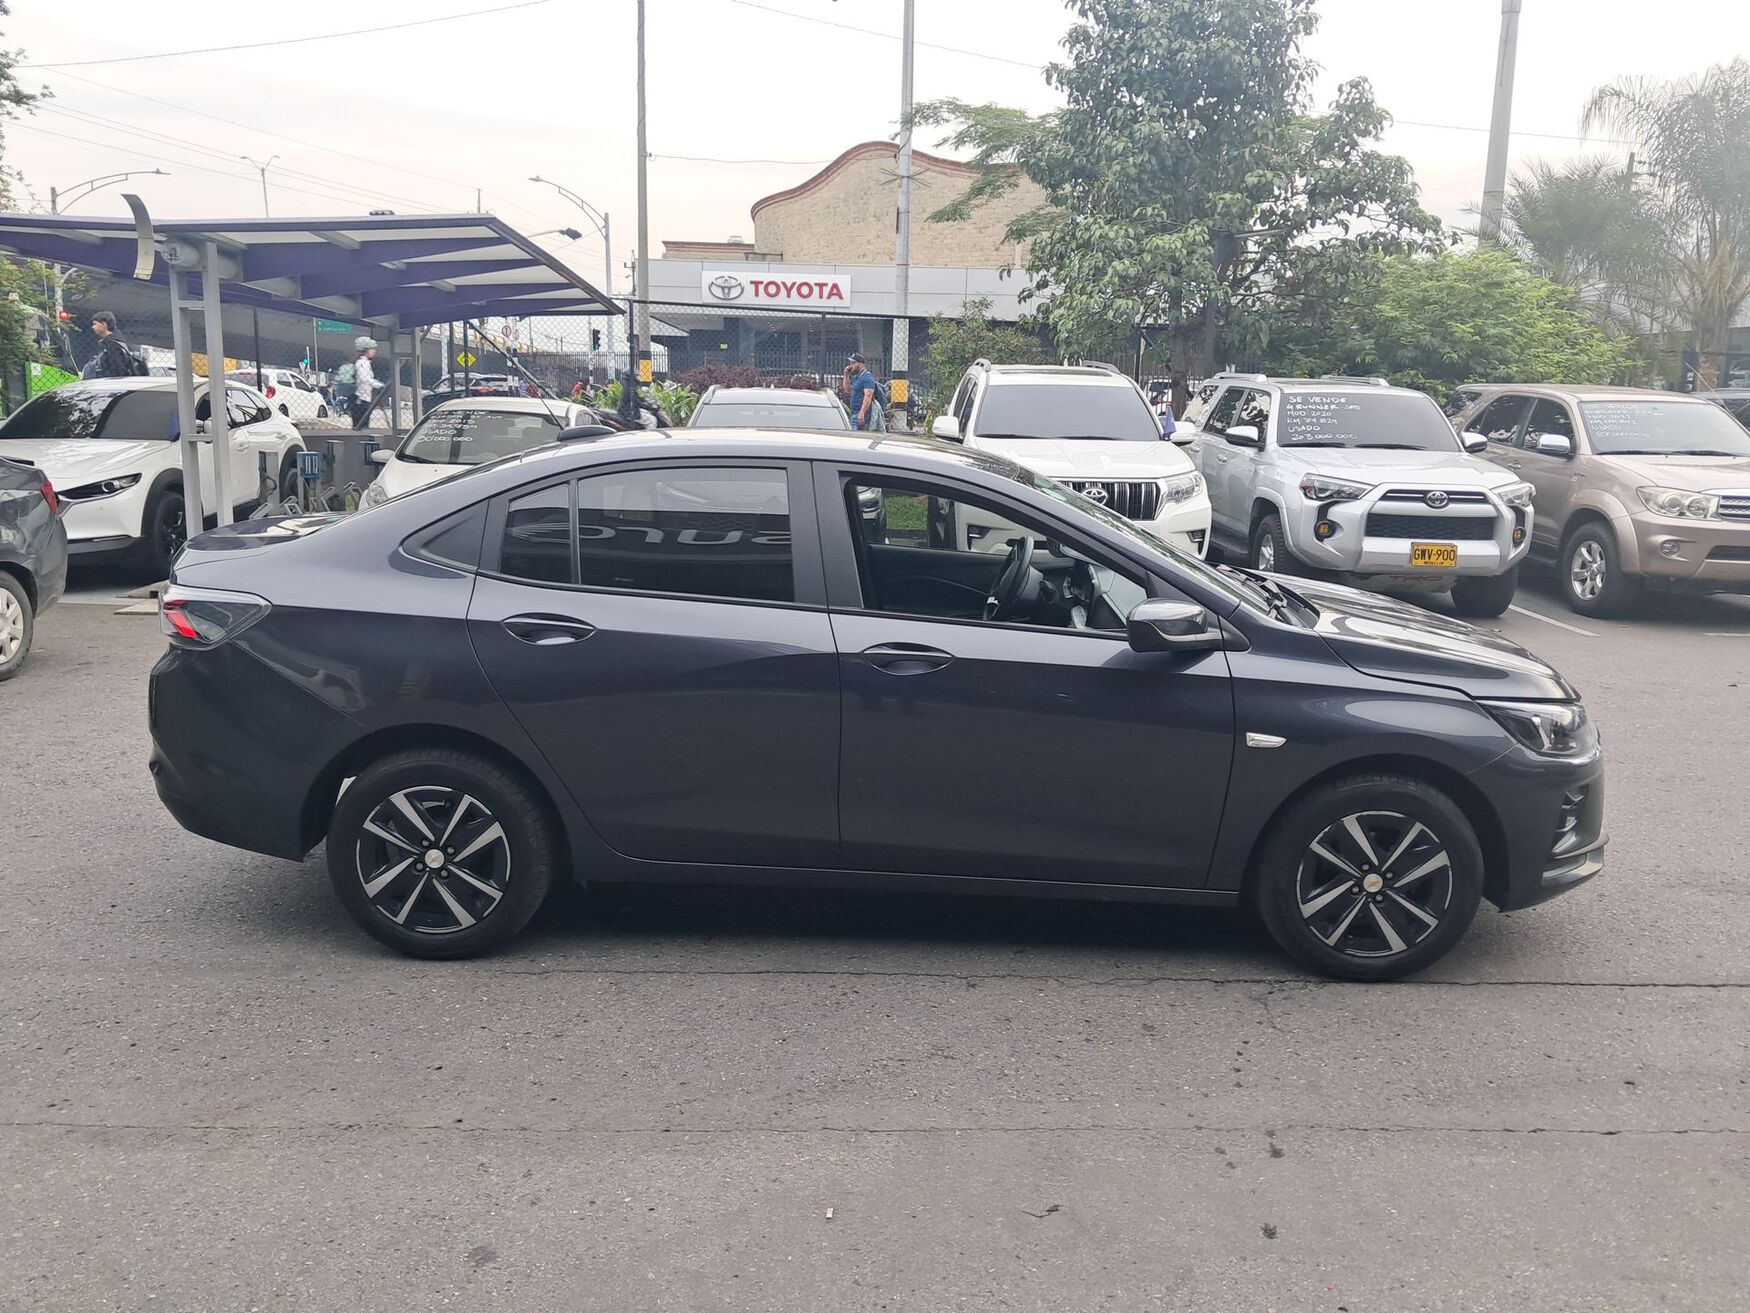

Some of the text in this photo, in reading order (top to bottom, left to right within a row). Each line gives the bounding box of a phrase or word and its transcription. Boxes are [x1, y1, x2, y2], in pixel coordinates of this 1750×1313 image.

[749, 280, 844, 300] TOYOTA
[1308, 396, 1347, 404] VENDE
[1413, 548, 1456, 562] GWV-900
